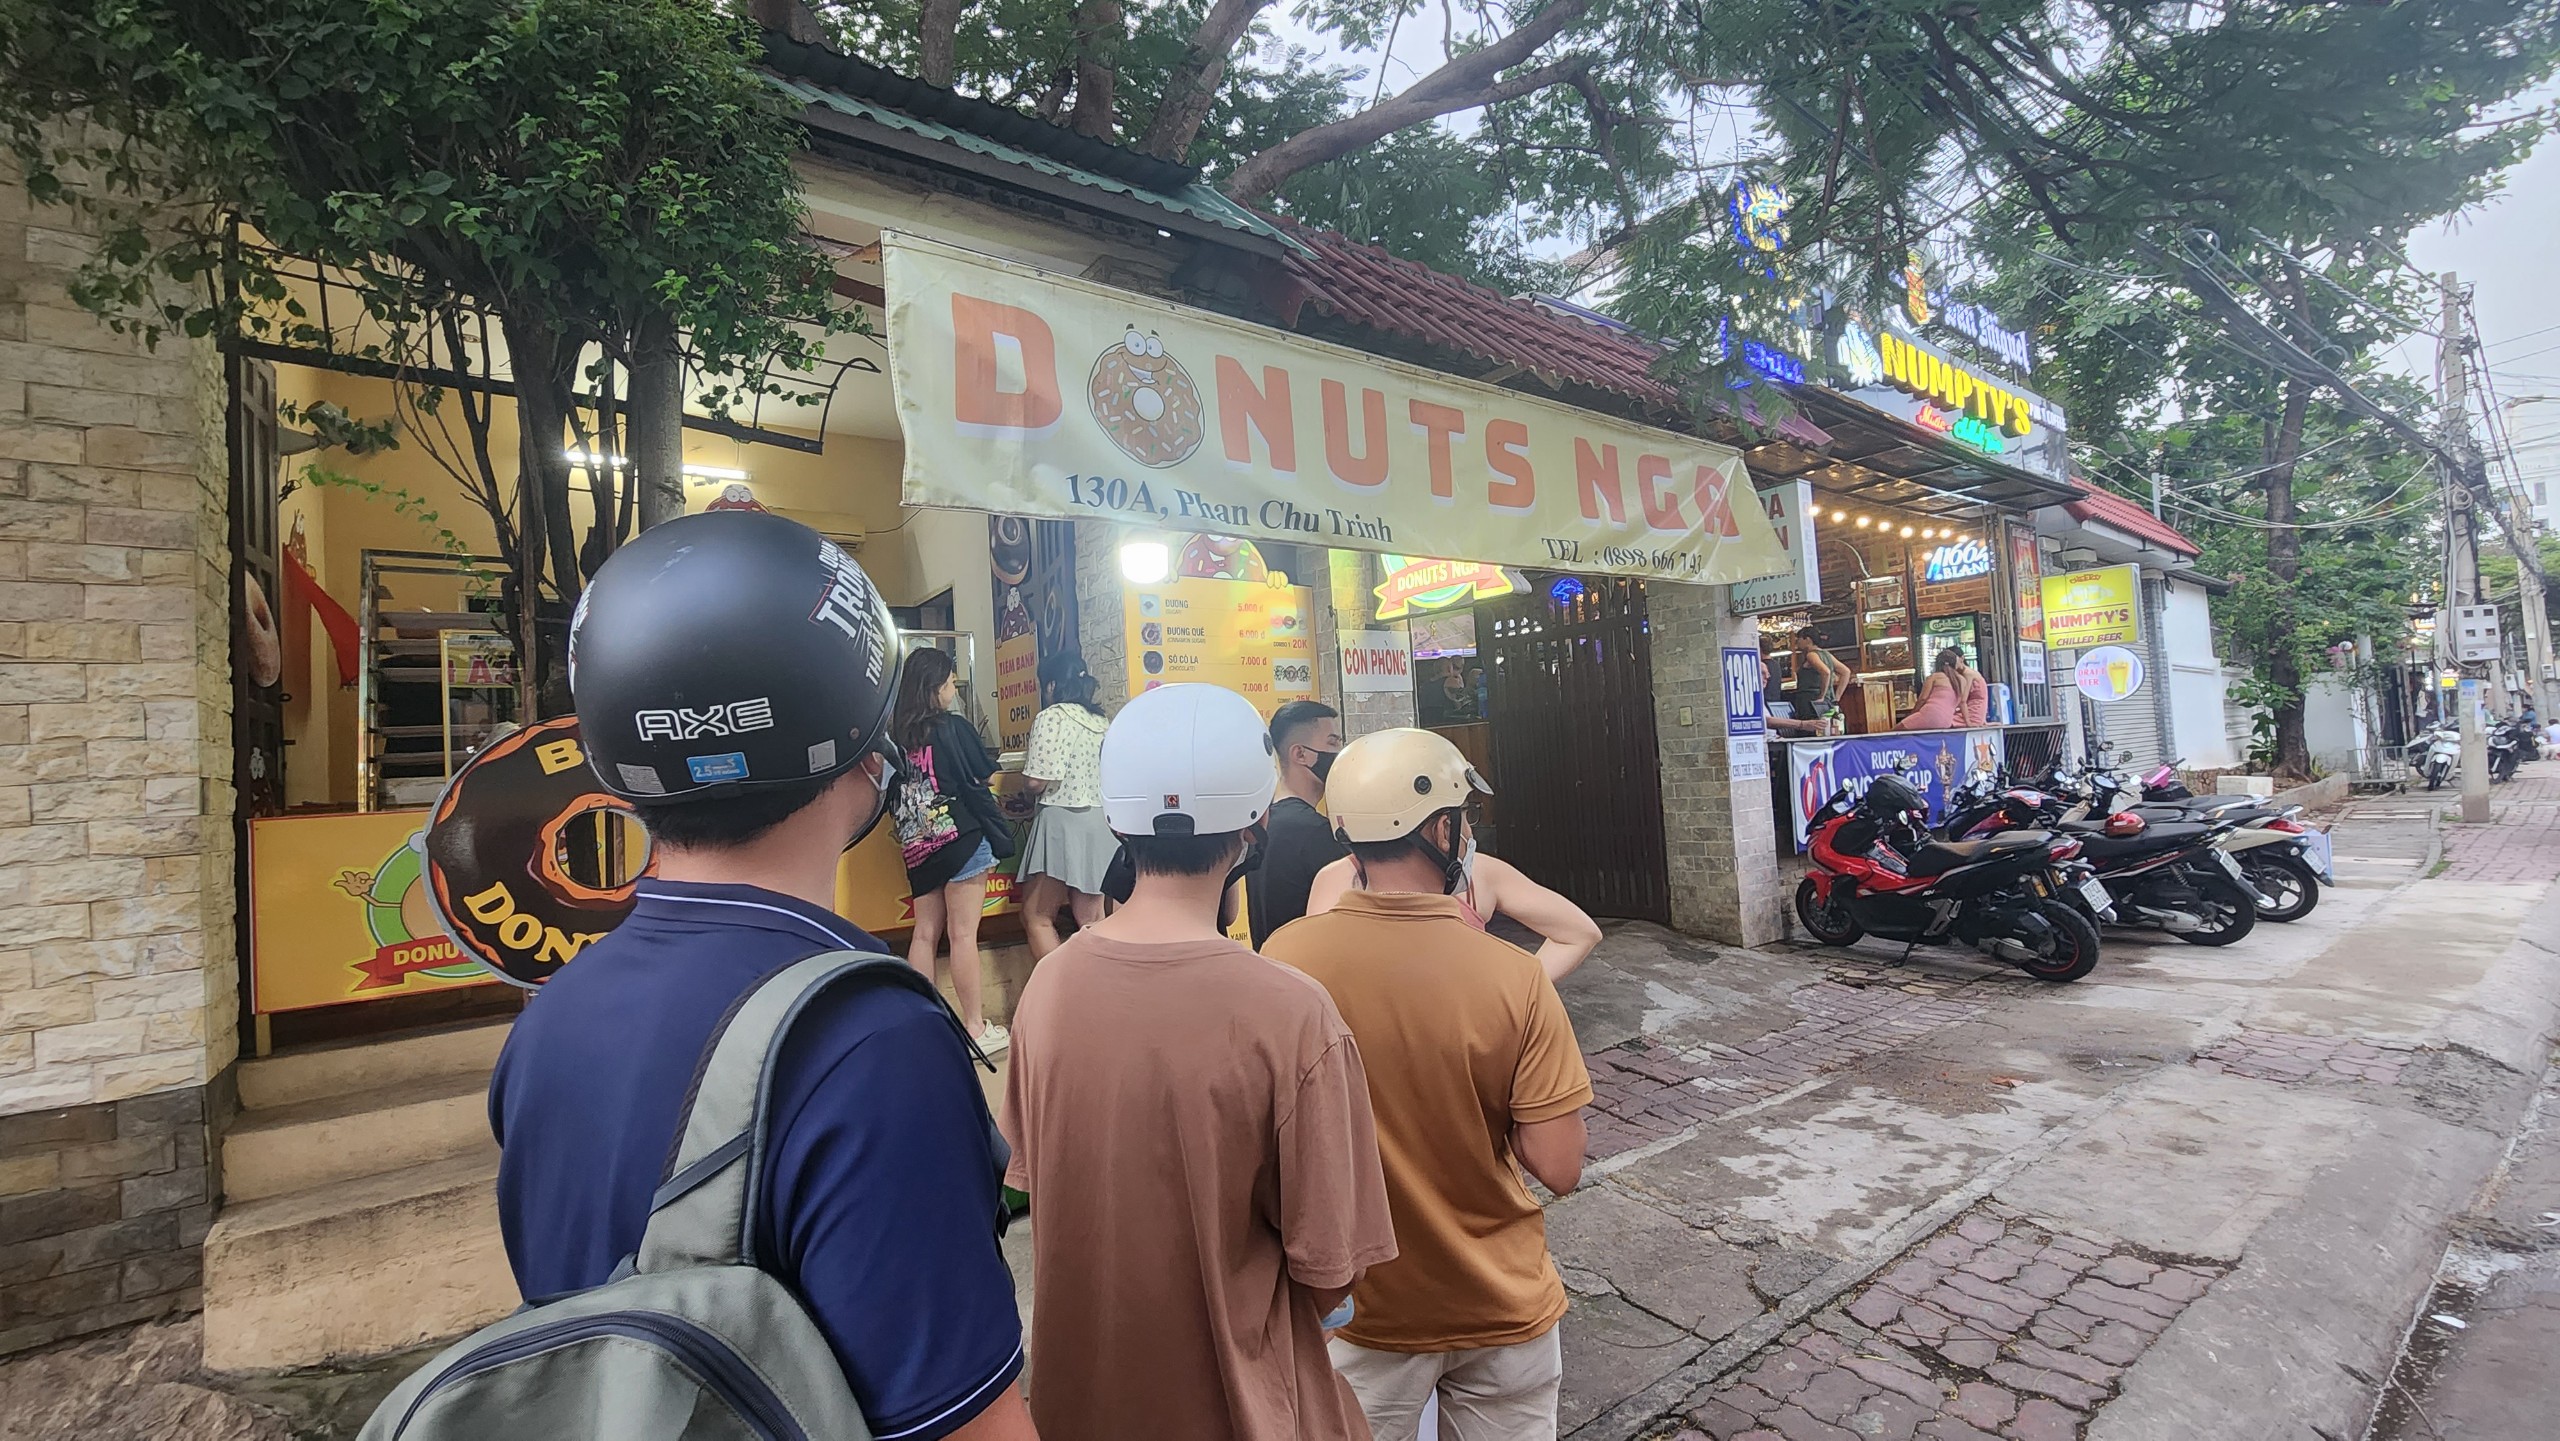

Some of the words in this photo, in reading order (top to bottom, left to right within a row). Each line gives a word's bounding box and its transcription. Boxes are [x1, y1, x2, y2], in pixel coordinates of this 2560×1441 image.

[1881, 332, 2031, 436] NUMPTY'S
[1574, 437, 1742, 542] NGA
[1066, 474, 1168, 521] 130A,
[1175, 488, 1250, 526] Phan
[1260, 499, 1319, 533] Chu
[1326, 508, 1394, 543] Trinh
[1541, 537, 1584, 563] TEL
[1604, 545, 1648, 568] 0898
[1652, 549, 1677, 571] 666
[1397, 563, 1448, 592] DONUTS
[1451, 560, 1480, 580] NGA
[1760, 593, 1778, 607] 092
[1781, 589, 1800, 603] 895
[1929, 615, 1967, 631] Carlsberg
[2049, 608, 2129, 630] NUMPTY'S
[1292, 639, 1308, 649] 20K
[2056, 635, 2095, 647] CHILLED
[2096, 632, 2123, 642] BEER
[1190, 656, 1199, 664] LA
[1241, 656, 1261, 666] 7.000
[1344, 639, 1369, 675] CÒN
[1371, 640, 1408, 675] PHÒNG
[1243, 683, 1263, 692] 7.000
[1726, 653, 1761, 716] 130A
[636, 697, 775, 742] AXE
[1010, 705, 1030, 723] OPEN
[1871, 749, 1906, 770] RUGBY
[985, 878, 1014, 893] NGA
